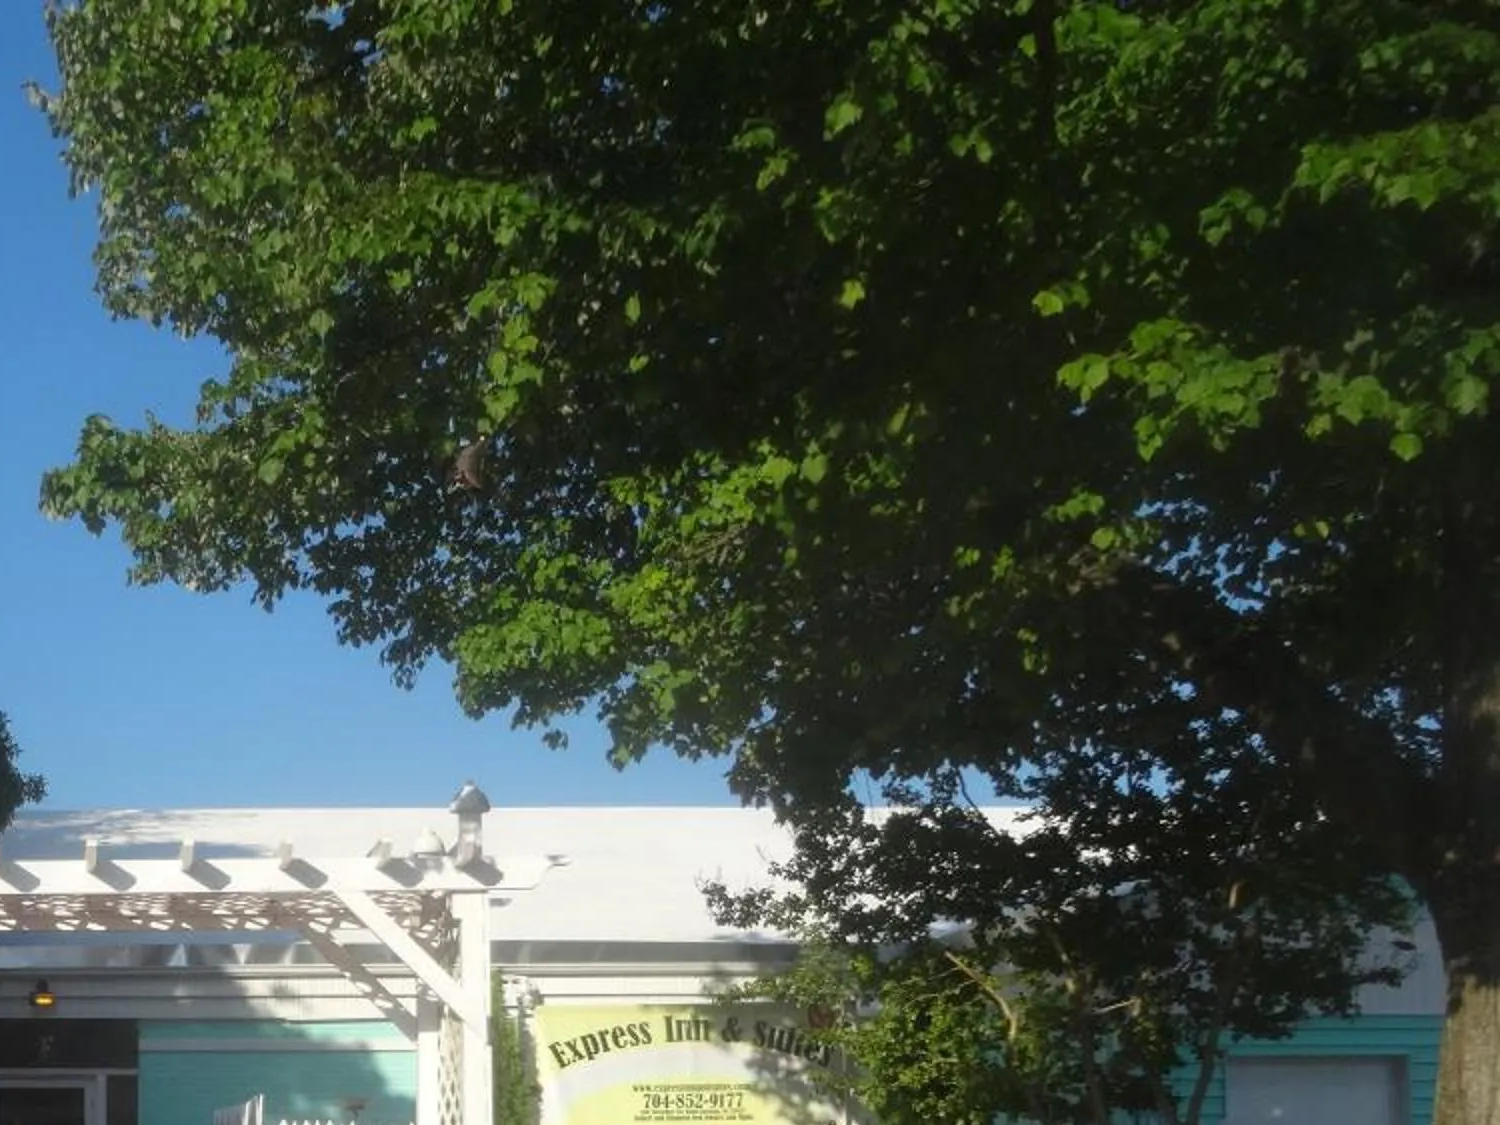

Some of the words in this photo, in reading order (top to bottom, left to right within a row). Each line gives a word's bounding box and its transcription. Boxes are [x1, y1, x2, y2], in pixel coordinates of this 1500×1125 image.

[548, 1019, 652, 1070] Express
[664, 1014, 713, 1043] Inn
[721, 1016, 743, 1043] &
[643, 1092, 744, 1109] 704-852-9177
